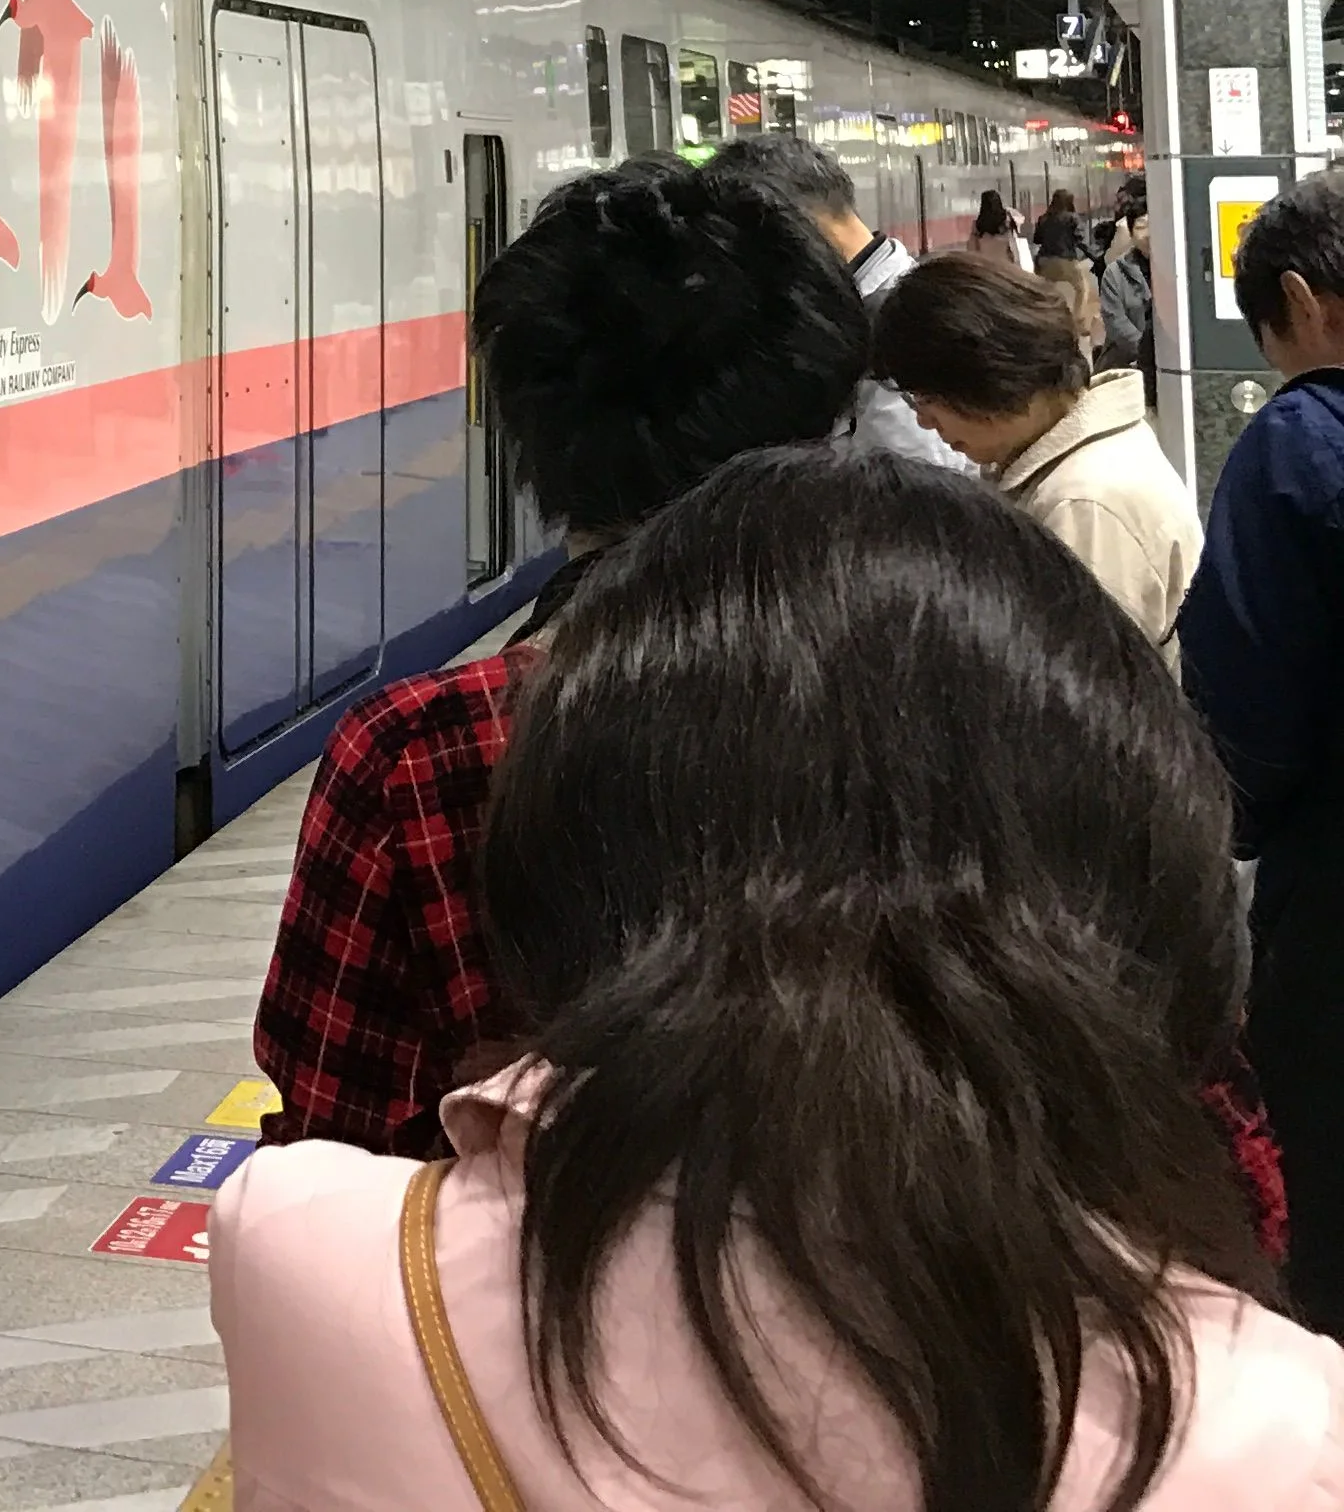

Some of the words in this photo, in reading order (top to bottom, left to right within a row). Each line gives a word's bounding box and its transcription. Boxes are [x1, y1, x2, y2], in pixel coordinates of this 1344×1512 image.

[1063, 16, 1079, 37] 7
[10, 332, 41, 364] Express
[8, 371, 40, 396] RAILWAY
[41, 365, 76, 387] COMPANY
